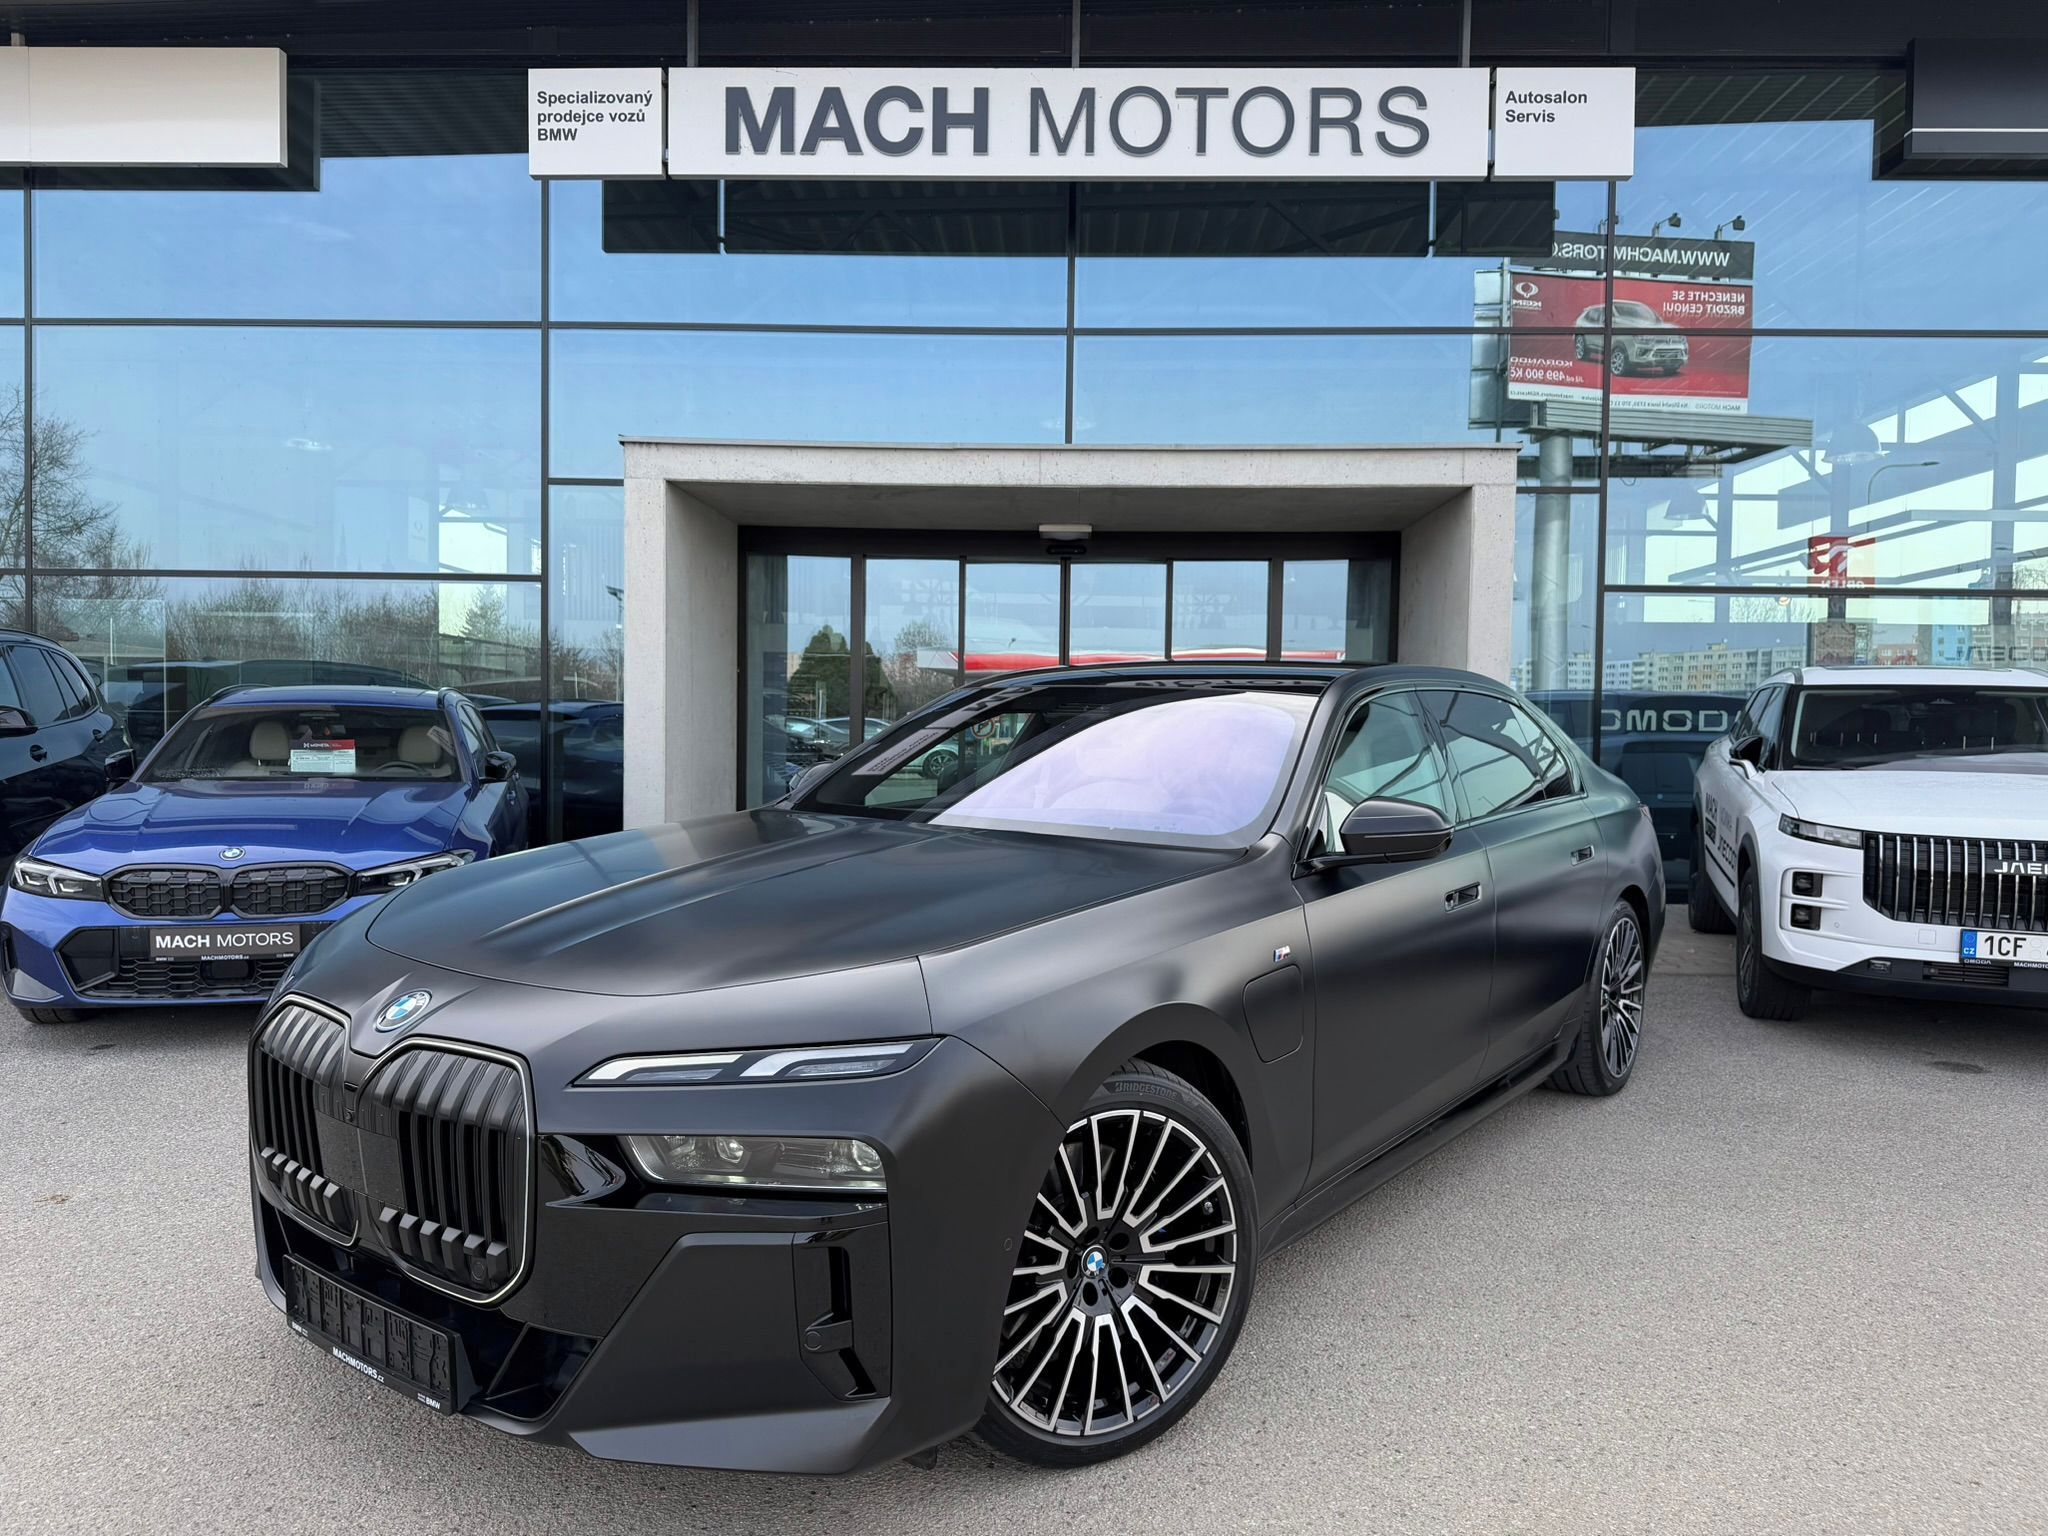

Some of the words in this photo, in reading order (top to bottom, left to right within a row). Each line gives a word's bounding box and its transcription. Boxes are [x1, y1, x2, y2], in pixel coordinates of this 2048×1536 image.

[537, 90, 653, 107] Specializovaný
[1505, 90, 1588, 104] Autosalon
[537, 109, 604, 126] prodejce
[609, 108, 645, 122] vozů
[725, 86, 990, 157] MACH
[1029, 85, 1430, 157] MOTORS
[1505, 109, 1556, 123] Servis
[537, 128, 578, 141] BMW
[155, 934, 210, 949] MACH
[217, 931, 294, 947] MOTORS
[1984, 935, 2027, 957] 1CF
[1963, 947, 1975, 955] CZ
[1115, 1082, 1177, 1100] BRIDGESTONE
[425, 1396, 441, 1411] BMW
